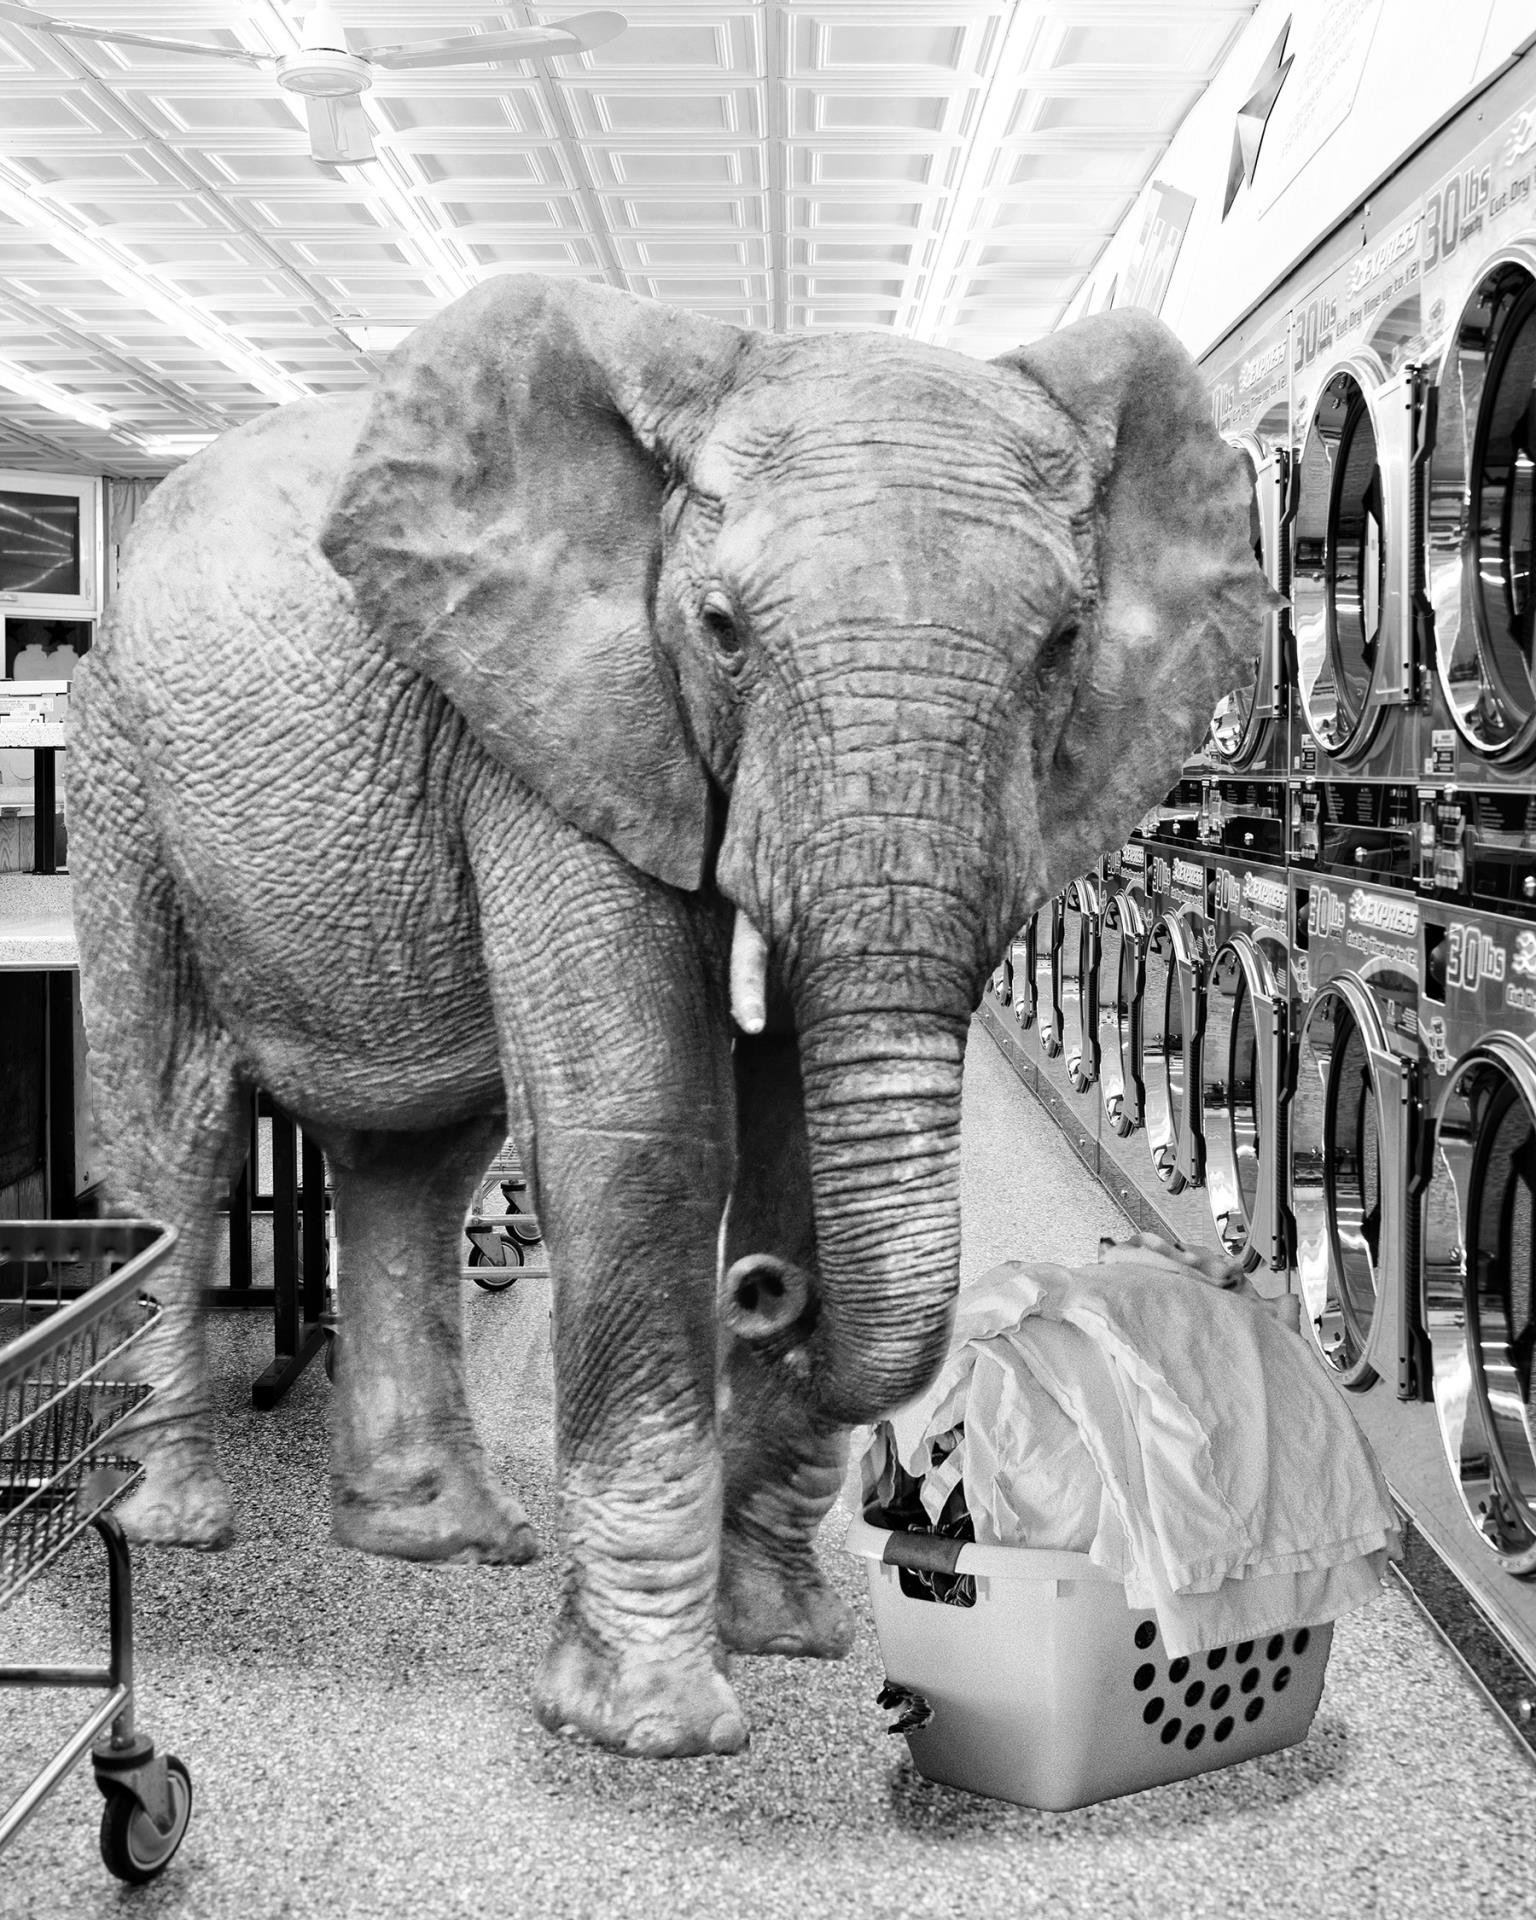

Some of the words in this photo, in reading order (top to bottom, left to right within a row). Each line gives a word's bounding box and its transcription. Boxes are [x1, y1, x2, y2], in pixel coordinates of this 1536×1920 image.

[1359, 215, 1422, 289] EXPRESS
[1250, 876, 1288, 913] EXPRESS
[1362, 893, 1419, 939] EXPRESS
